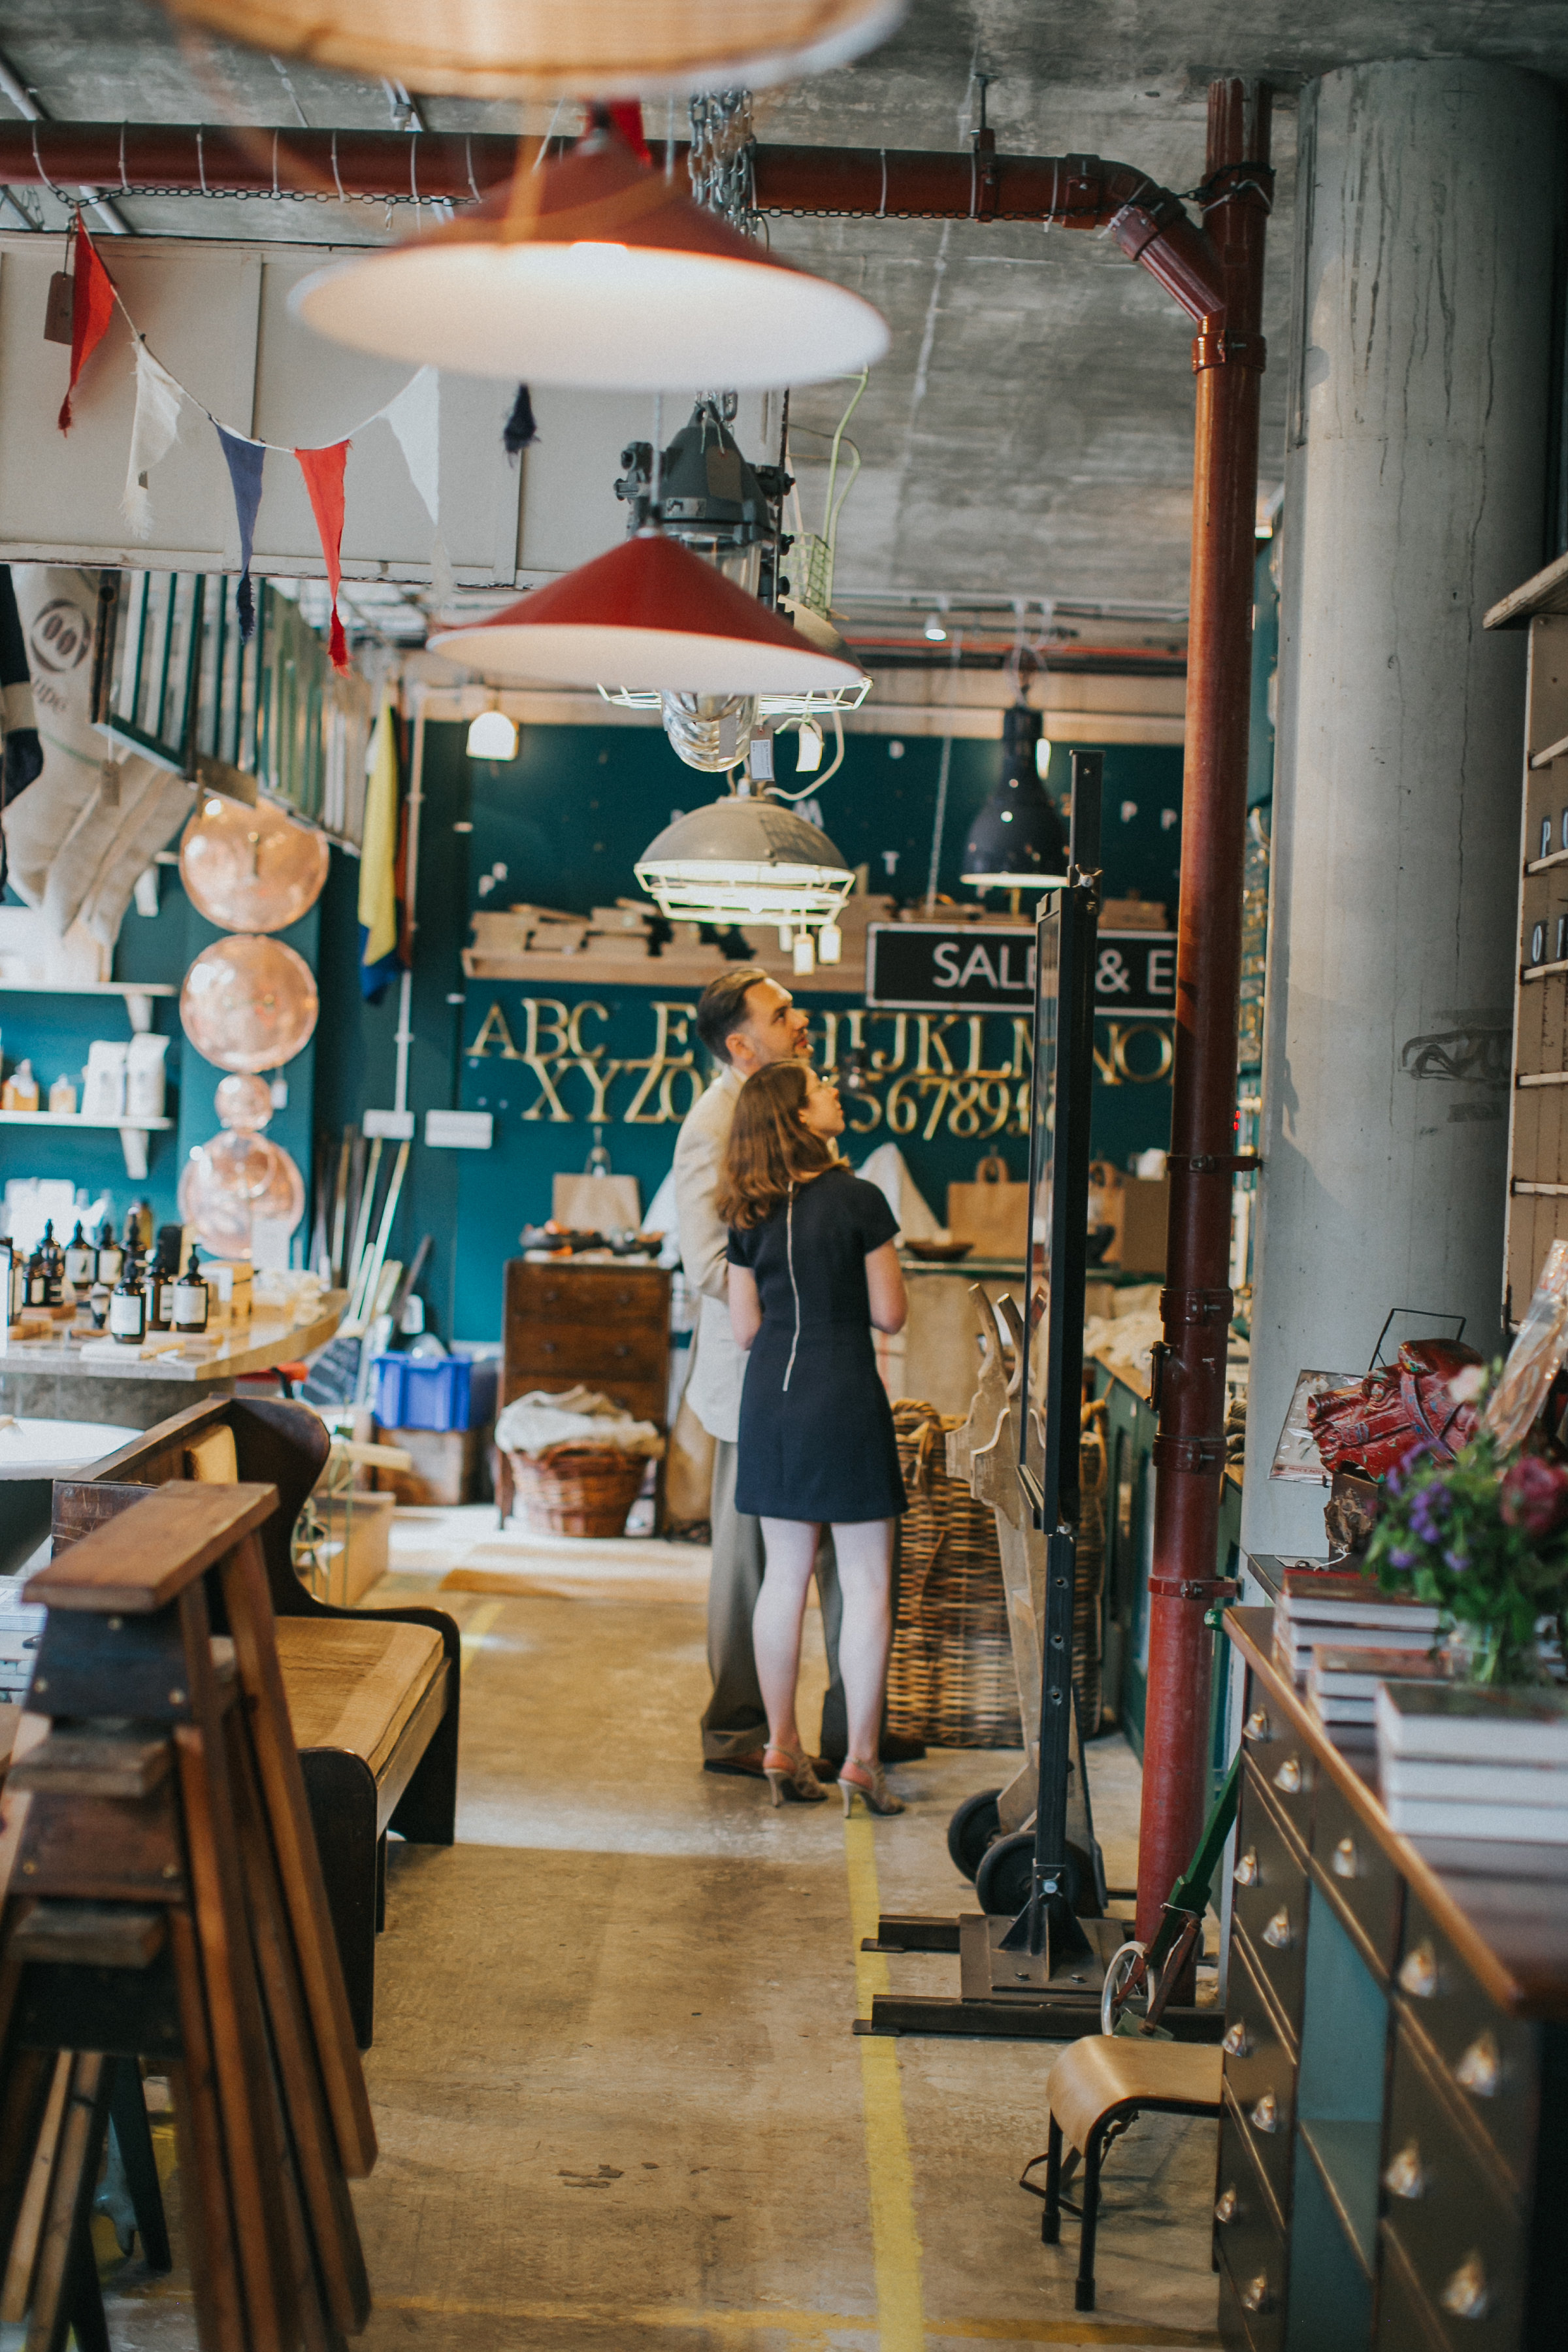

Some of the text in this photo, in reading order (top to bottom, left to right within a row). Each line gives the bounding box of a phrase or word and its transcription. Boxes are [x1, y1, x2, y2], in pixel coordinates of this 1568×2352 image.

[1541, 821, 1551, 858] P
[881, 851, 900, 875] T
[1096, 949, 1130, 993] &
[1147, 950, 1174, 994] E
[466, 998, 609, 1061] ABC
